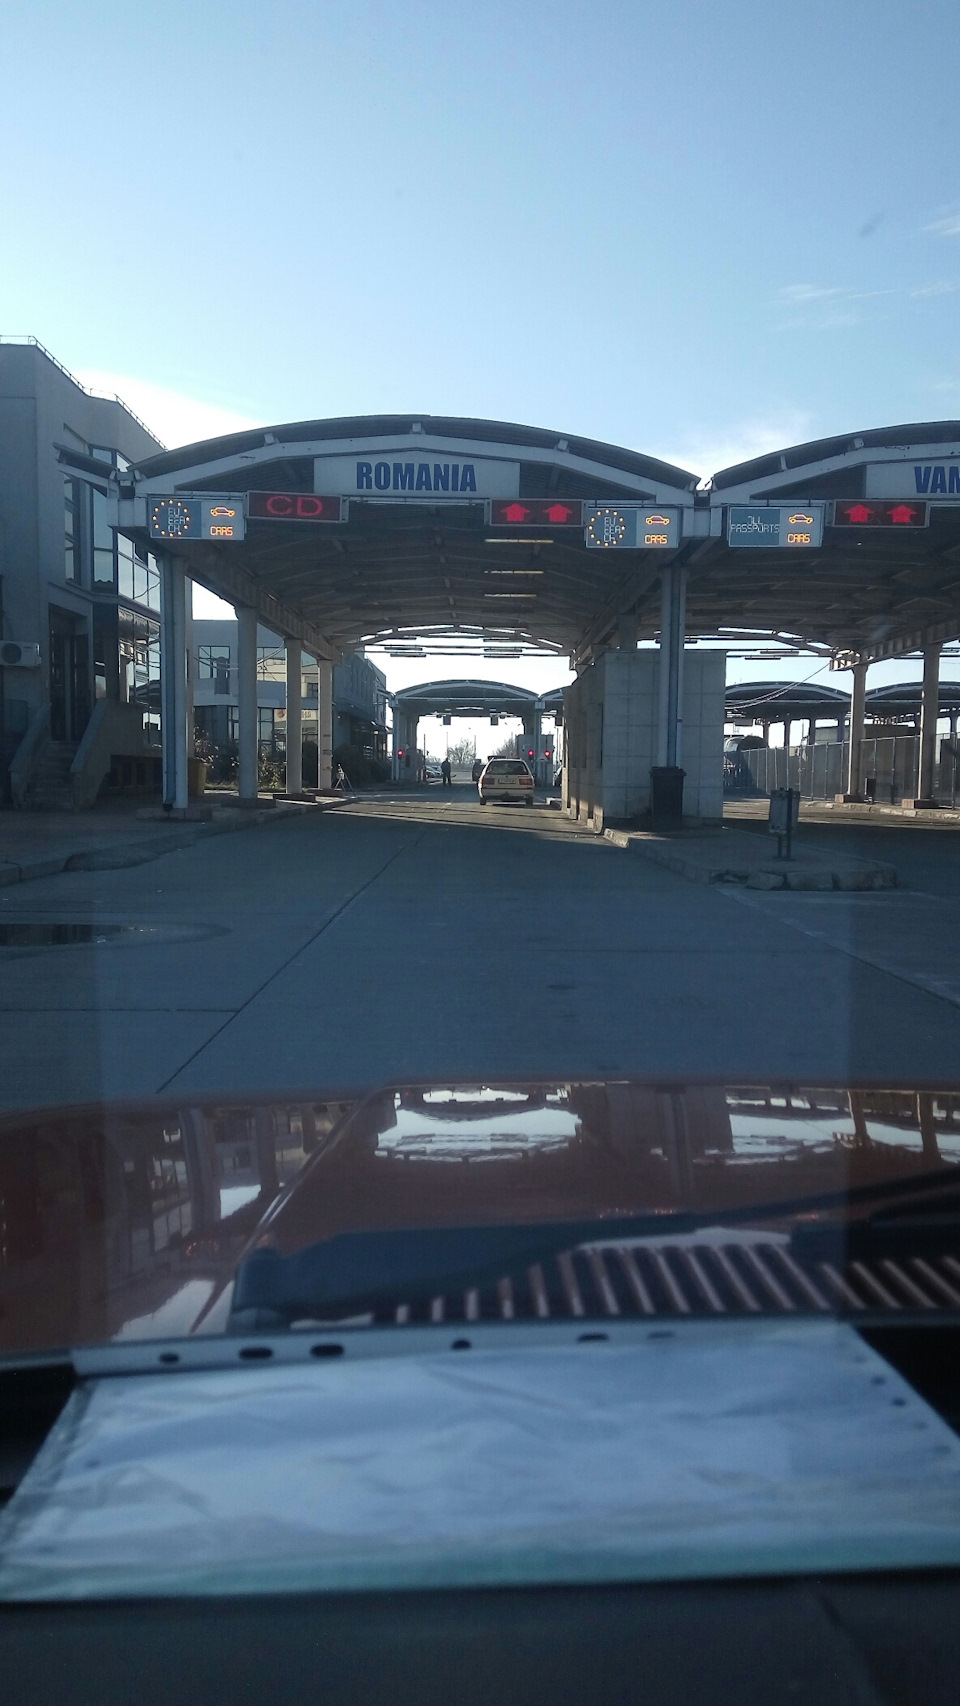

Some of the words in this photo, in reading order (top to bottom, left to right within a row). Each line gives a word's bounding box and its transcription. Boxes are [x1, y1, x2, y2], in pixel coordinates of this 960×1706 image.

[356, 461, 477, 492] ROMANIA
[266, 495, 323, 517] CD
[168, 507, 180, 516] EU
[604, 517, 617, 526] EU
[168, 525, 180, 533] CH
[210, 526, 234, 536] CARS
[731, 523, 780, 534] PASSPORTS
[645, 534, 668, 544] CARS
[787, 533, 811, 543] CARS
